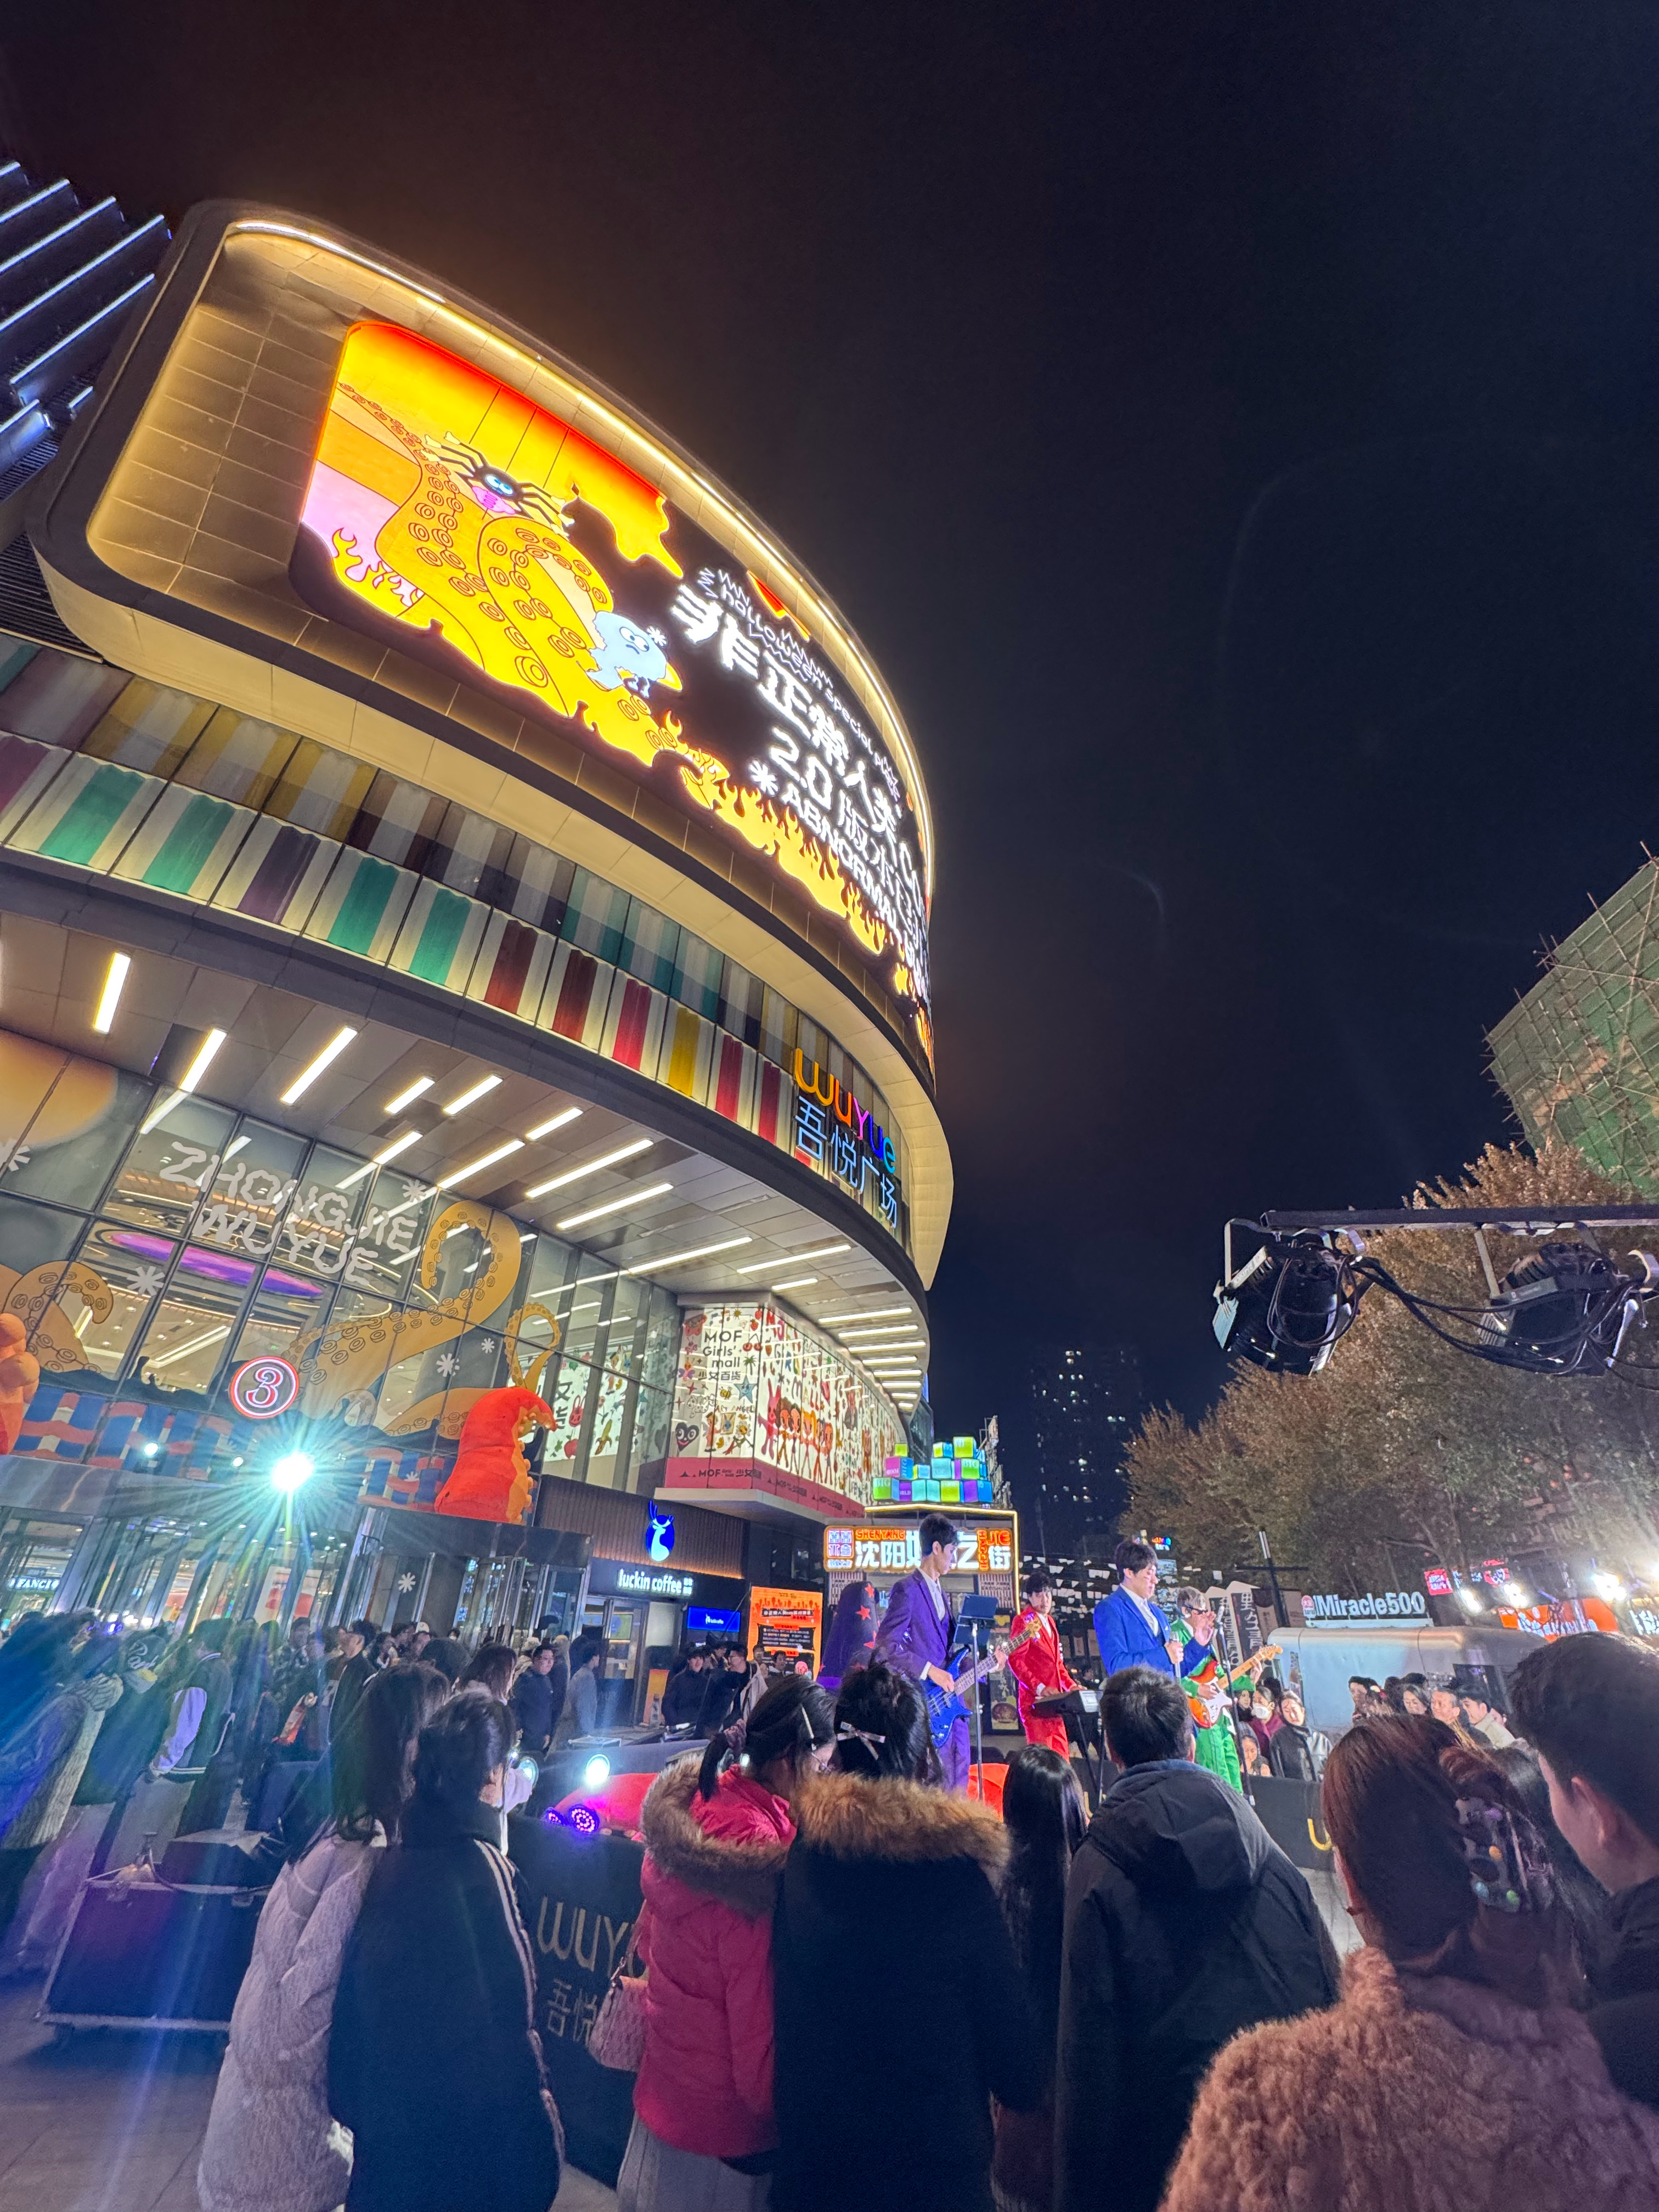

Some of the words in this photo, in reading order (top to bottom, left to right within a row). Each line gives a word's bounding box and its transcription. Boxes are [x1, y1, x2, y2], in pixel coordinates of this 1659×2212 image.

[795, 1096, 897, 1228] 吾悦广场
[189, 1200, 379, 1285] WUYUE
[704, 1330, 742, 1343] MOF
[712, 1357, 740, 1368] mall
[698, 1370, 741, 1381] 少女百货
[245, 1367, 284, 1408] 3
[855, 1529, 906, 1541] SHENYANG
[988, 1531, 1011, 1545] JIE
[618, 1568, 651, 1590] luckin
[652, 1573, 682, 1594] coffee
[1316, 1592, 1425, 1616] Miracle500
